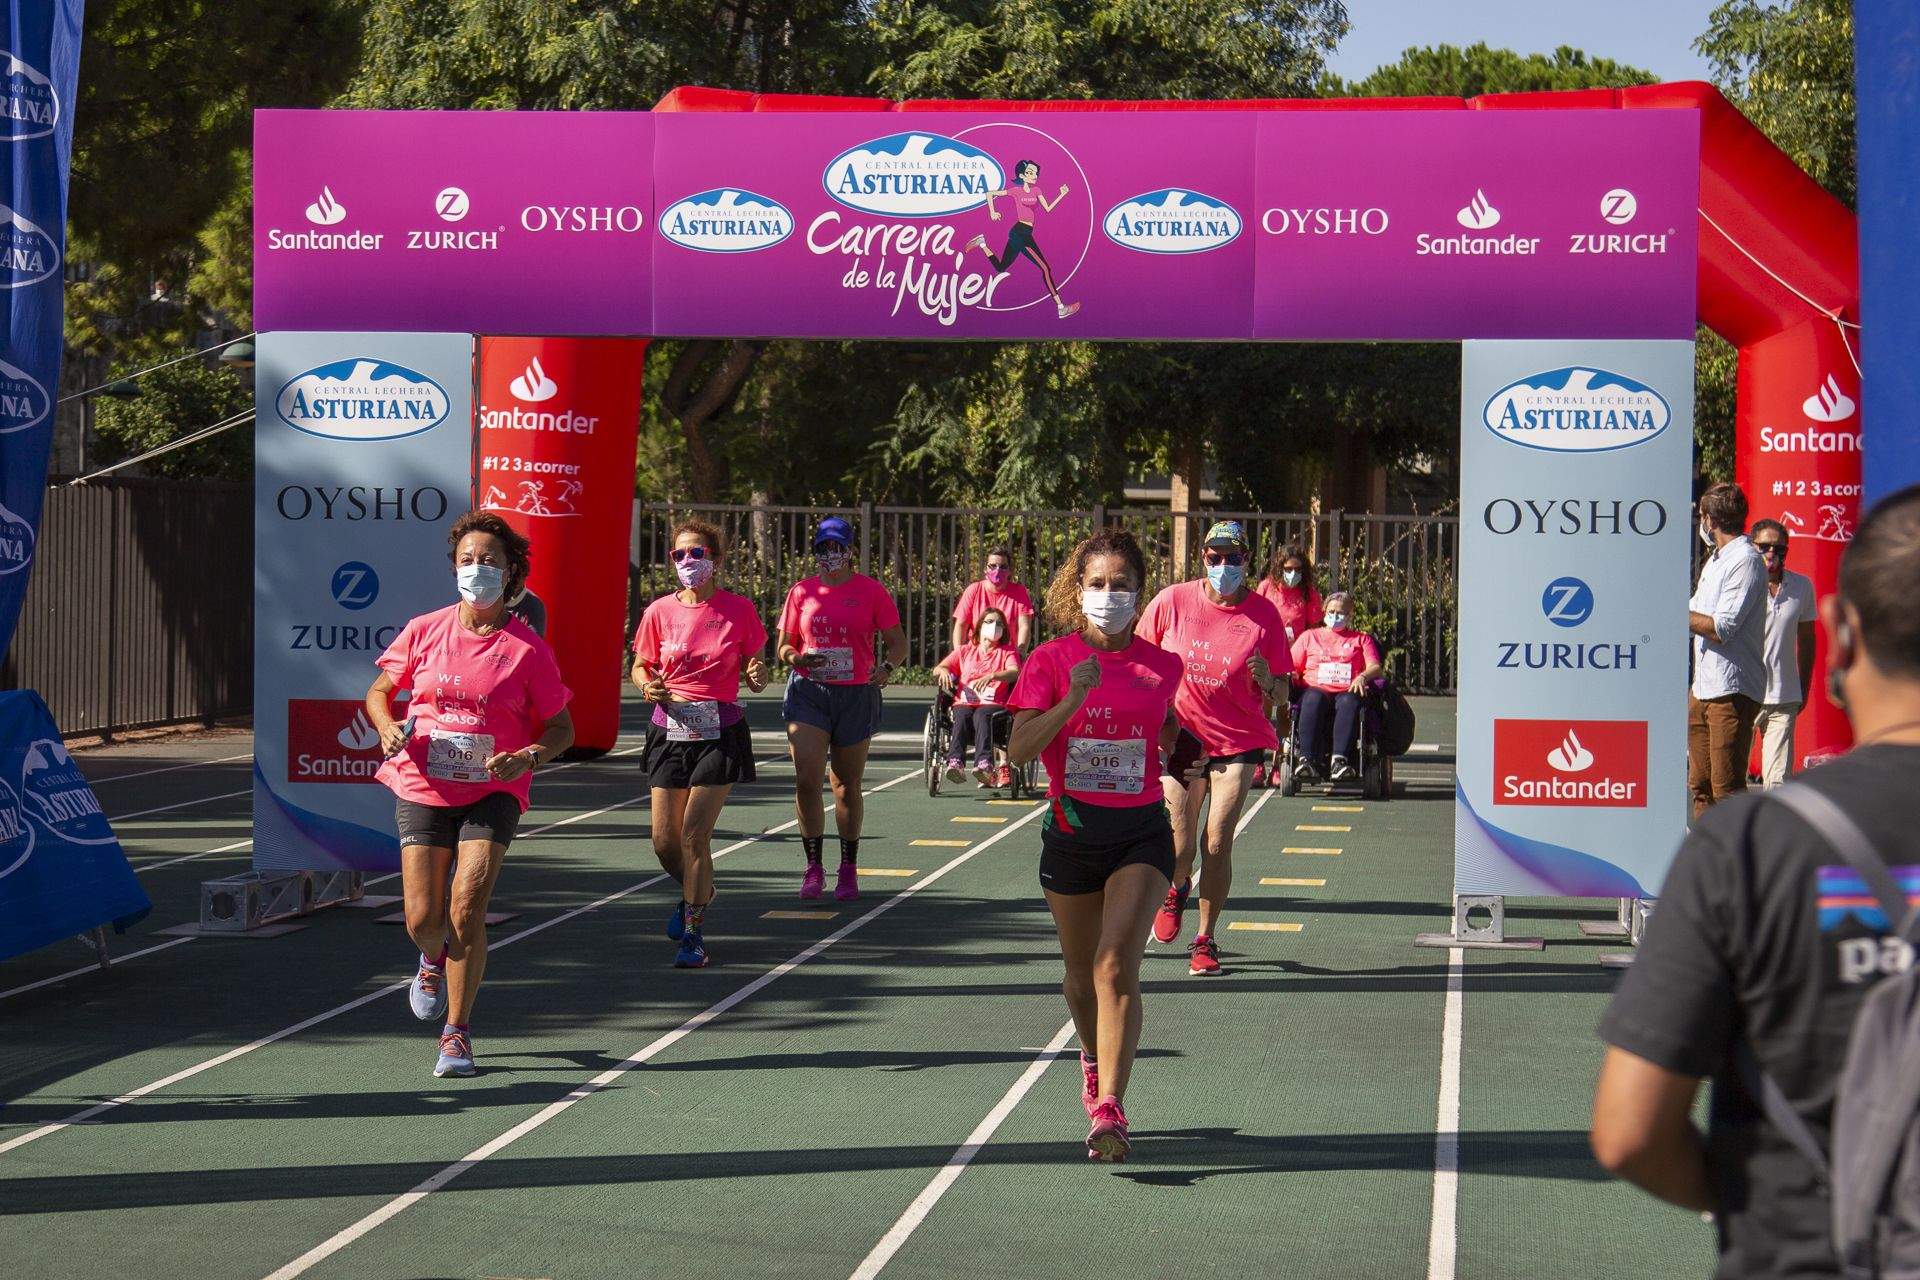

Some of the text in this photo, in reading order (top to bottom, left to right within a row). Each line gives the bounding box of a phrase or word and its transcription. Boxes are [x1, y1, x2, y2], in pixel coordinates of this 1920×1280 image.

[837, 163, 990, 195] ASTURIANA
[521, 206, 643, 232] OYSHO
[670, 211, 783, 235] ASTURIANA
[1114, 212, 1231, 236] ASTURIANA
[1262, 208, 1389, 235] OYSHO
[268, 229, 384, 250] Santander
[407, 231, 498, 250] ZURICH
[806, 211, 956, 256] Carrera
[1416, 234, 1540, 255] Santander
[1569, 234, 1667, 253] ZURICH
[0, 246, 45, 273] ANA
[842, 252, 1011, 326] de la Mujer
[315, 386, 432, 395] CENTRAL LECHERA
[1527, 396, 1651, 405] CENTRAL LECHERA
[1, 394, 35, 419] NA
[288, 388, 437, 420] ASTURIANA
[1497, 398, 1656, 430] ASTURIANA
[480, 406, 599, 434] Santander
[1760, 427, 1864, 452] Santan
[277, 485, 448, 522] OYSHO
[1484, 499, 1667, 536] OYSHO
[291, 625, 405, 650] ZURIC
[670, 642, 688, 651] WE
[1192, 639, 1210, 650] WE
[1187, 650, 1232, 665] RUN
[1497, 643, 1638, 669] ZURICH
[438, 672, 462, 686] WE
[1187, 662, 1229, 678] FOR A
[436, 687, 488, 704] RUN
[1086, 707, 1112, 719] WE
[1085, 723, 1143, 737] RUN
[298, 754, 381, 777] Santan
[448, 749, 473, 761] 016
[1091, 756, 1120, 768] 016
[1504, 776, 1637, 799] Santander
[1838, 936, 1914, 983] pa
